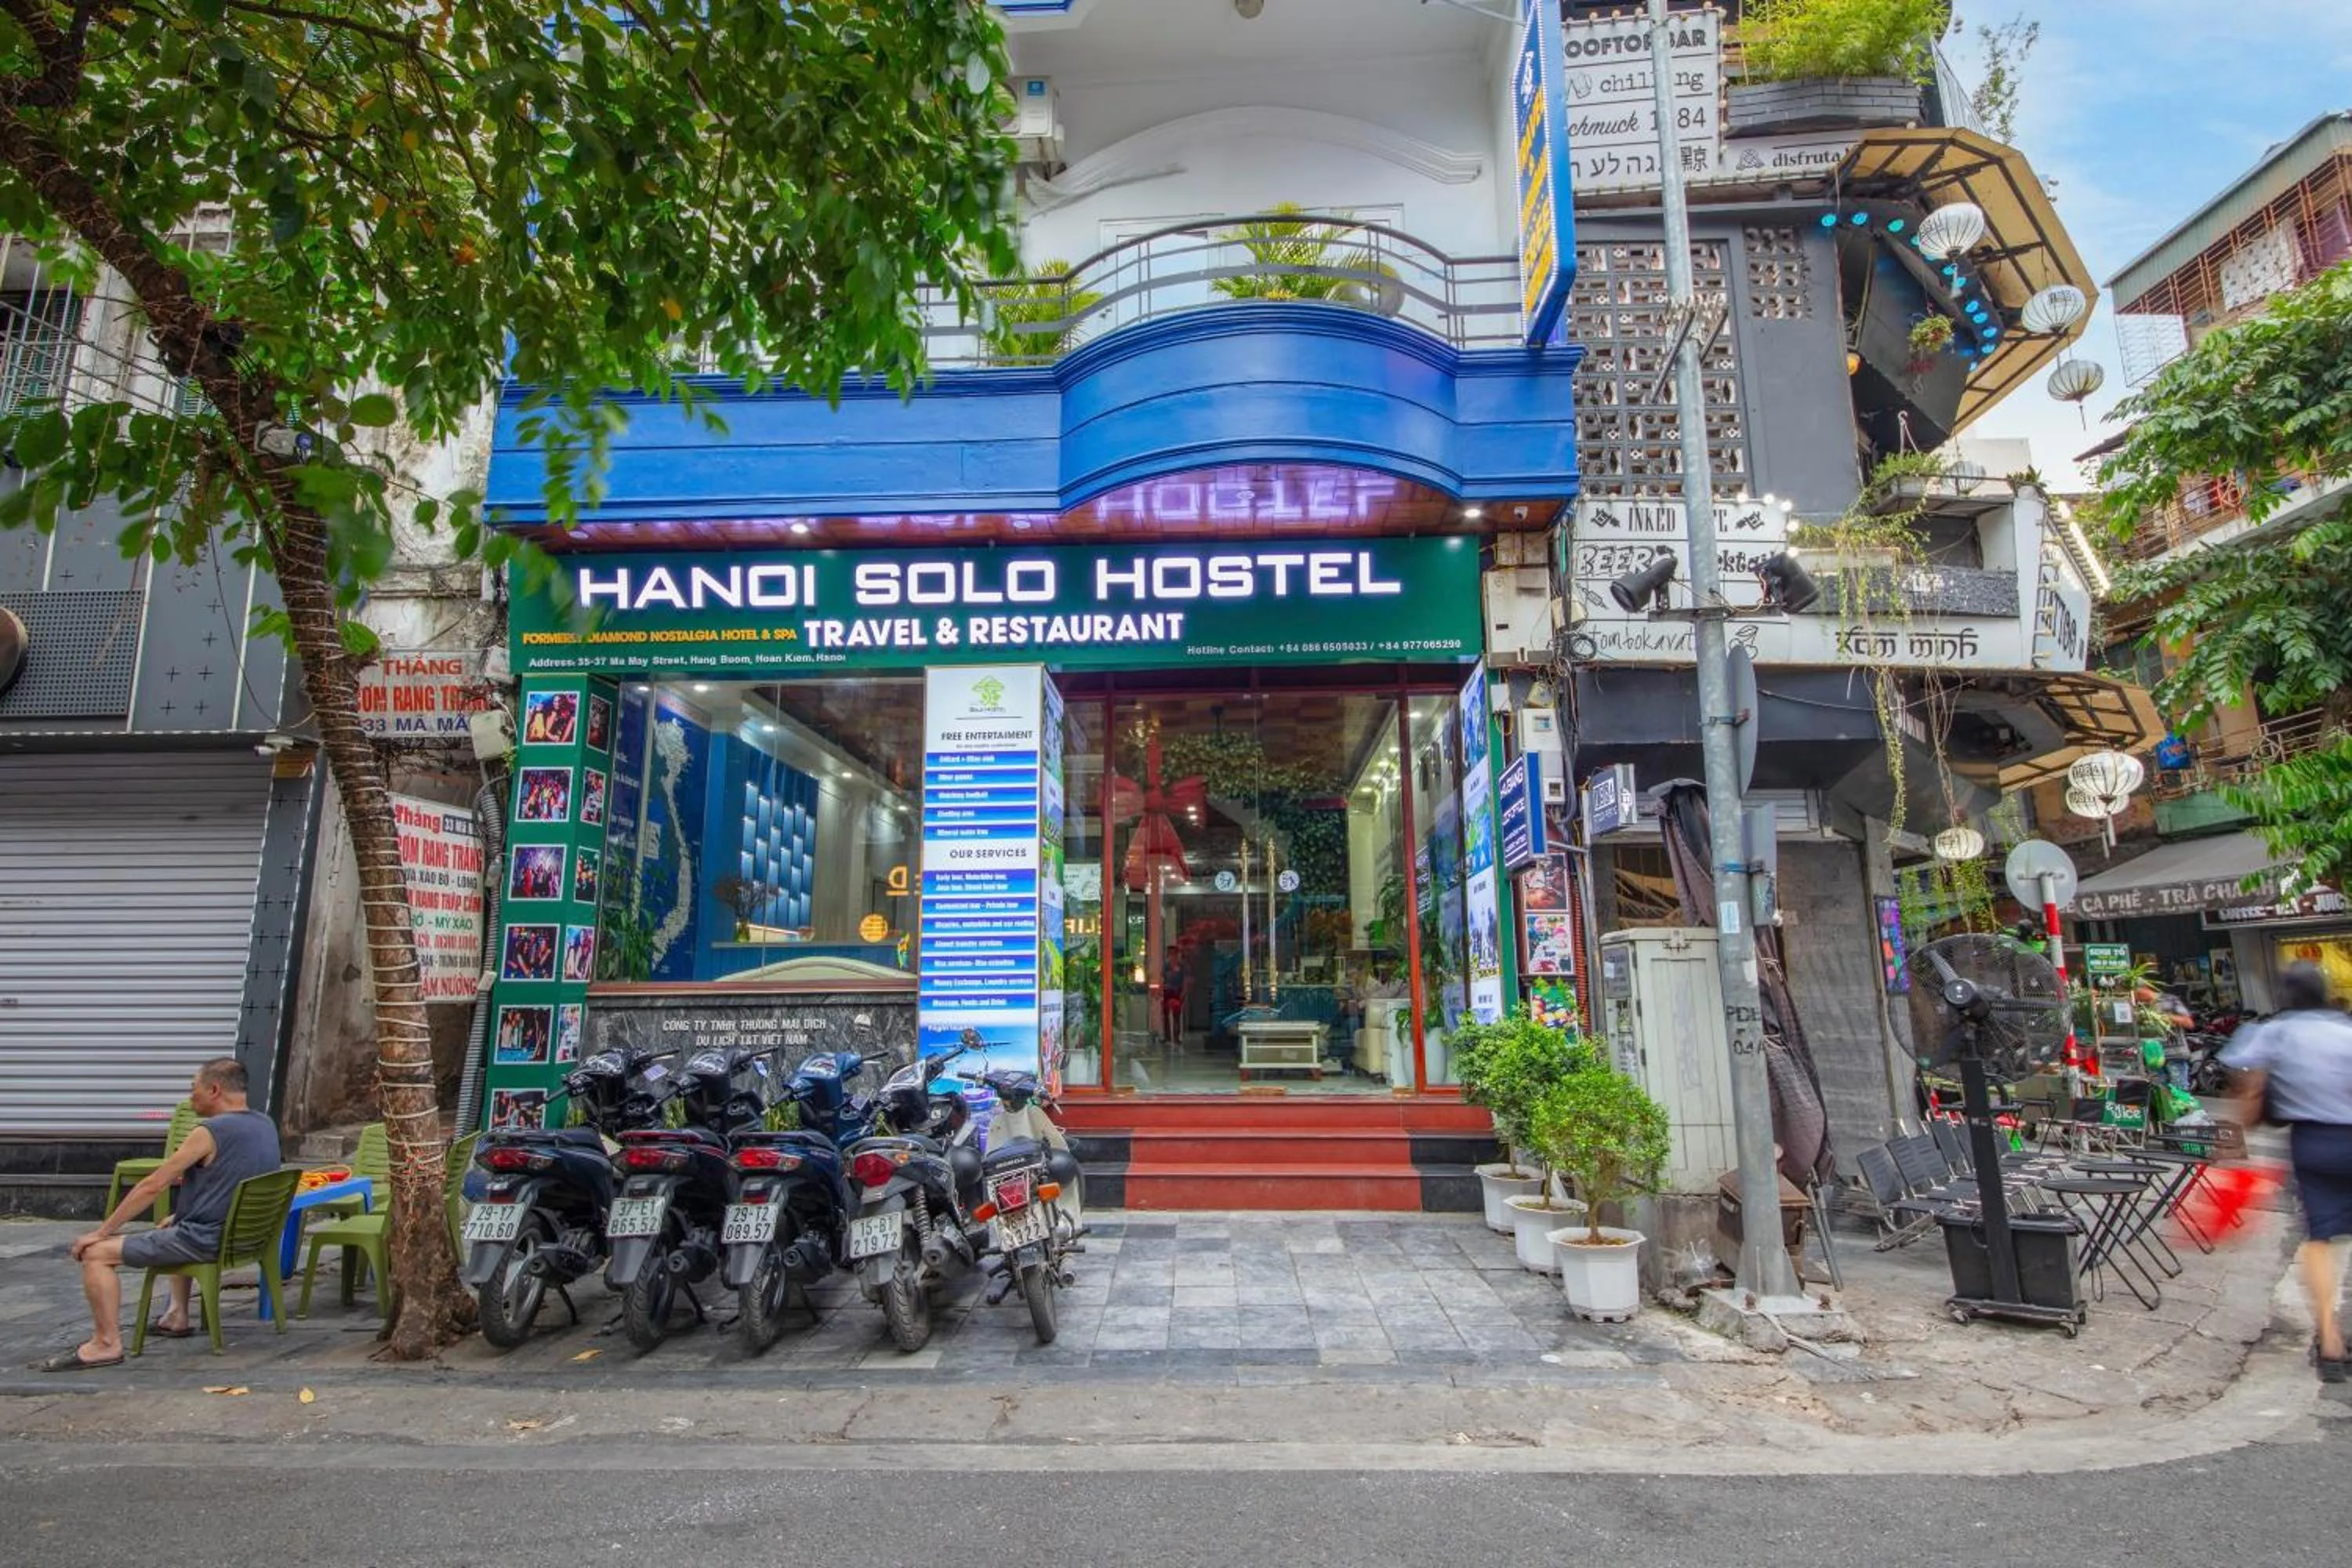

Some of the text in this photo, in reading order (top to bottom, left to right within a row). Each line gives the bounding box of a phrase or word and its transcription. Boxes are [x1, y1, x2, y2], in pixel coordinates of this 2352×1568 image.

[1568, 109, 1639, 137] chmuck
[579, 552, 1402, 610] HANOI SOLO HOSTEL
[650, 630, 718, 642] NOSTALGIA
[721, 630, 758, 641] HOTEL
[774, 629, 797, 640] SPA
[804, 612, 1185, 648] TRAVEL & RESTAURANT
[393, 684, 436, 714] RANG
[949, 847, 1028, 859] OUR SERVICES
